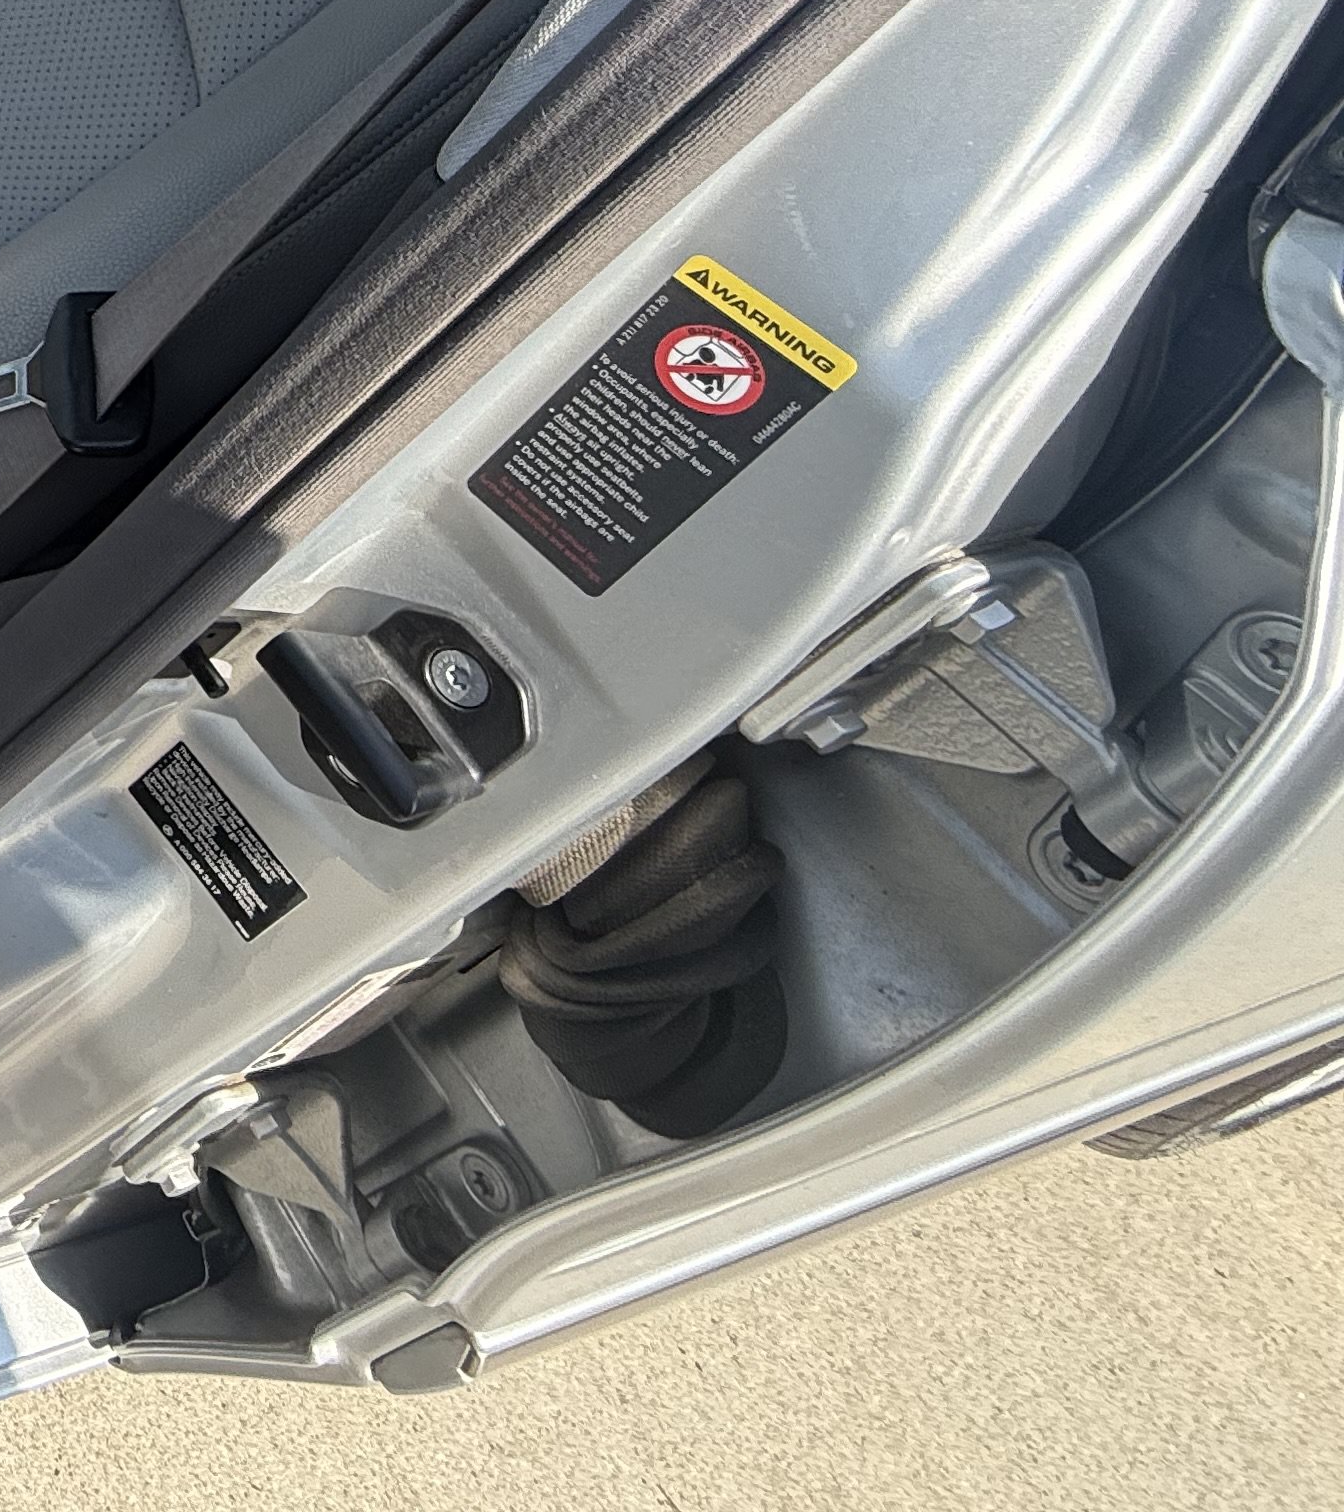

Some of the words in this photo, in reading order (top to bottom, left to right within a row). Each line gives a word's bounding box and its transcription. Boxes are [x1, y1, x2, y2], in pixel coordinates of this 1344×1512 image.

[712, 281, 836, 374] WARNING
[553, 413, 588, 442] Always
[586, 440, 601, 451] sit
[563, 404, 580, 419] the
[579, 418, 610, 444] airbag
[608, 440, 644, 473] inflates.
[572, 396, 608, 425] window
[631, 443, 662, 469] where
[580, 387, 604, 406] their
[602, 404, 632, 429] heads
[631, 428, 655, 446] near
[654, 445, 672, 461] the
[599, 353, 611, 365] To
[609, 364, 637, 385] avoid
[635, 383, 670, 411] serious
[668, 408, 697, 432] injury
[696, 430, 709, 440] or
[708, 439, 740, 465] death:
[629, 410, 663, 437] should
[660, 436, 690, 460] never
[689, 456, 712, 476] lean
[650, 411, 699, 450] especially
[504, 461, 531, 486] inside
[530, 484, 547, 499] the
[546, 498, 568, 519] seat.
[512, 454, 542, 480] covers
[541, 478, 551, 486] if
[549, 484, 566, 500] the
[564, 499, 599, 529] airbags
[598, 527, 615, 542] are
[520, 445, 535, 459] Do
[534, 458, 552, 473] not
[550, 471, 568, 486] use
[567, 485, 614, 525] accessory
[612, 524, 635, 543] seat
[529, 438, 567, 470] restraint
[566, 469, 605, 504] systems.
[537, 430, 557, 446] and
[555, 444, 573, 460] use
[572, 459, 625, 503] appropriate
[624, 502, 649, 523] child
[544, 421, 584, 453] properly
[583, 452, 601, 467] use
[600, 466, 643, 503] seatbelts
